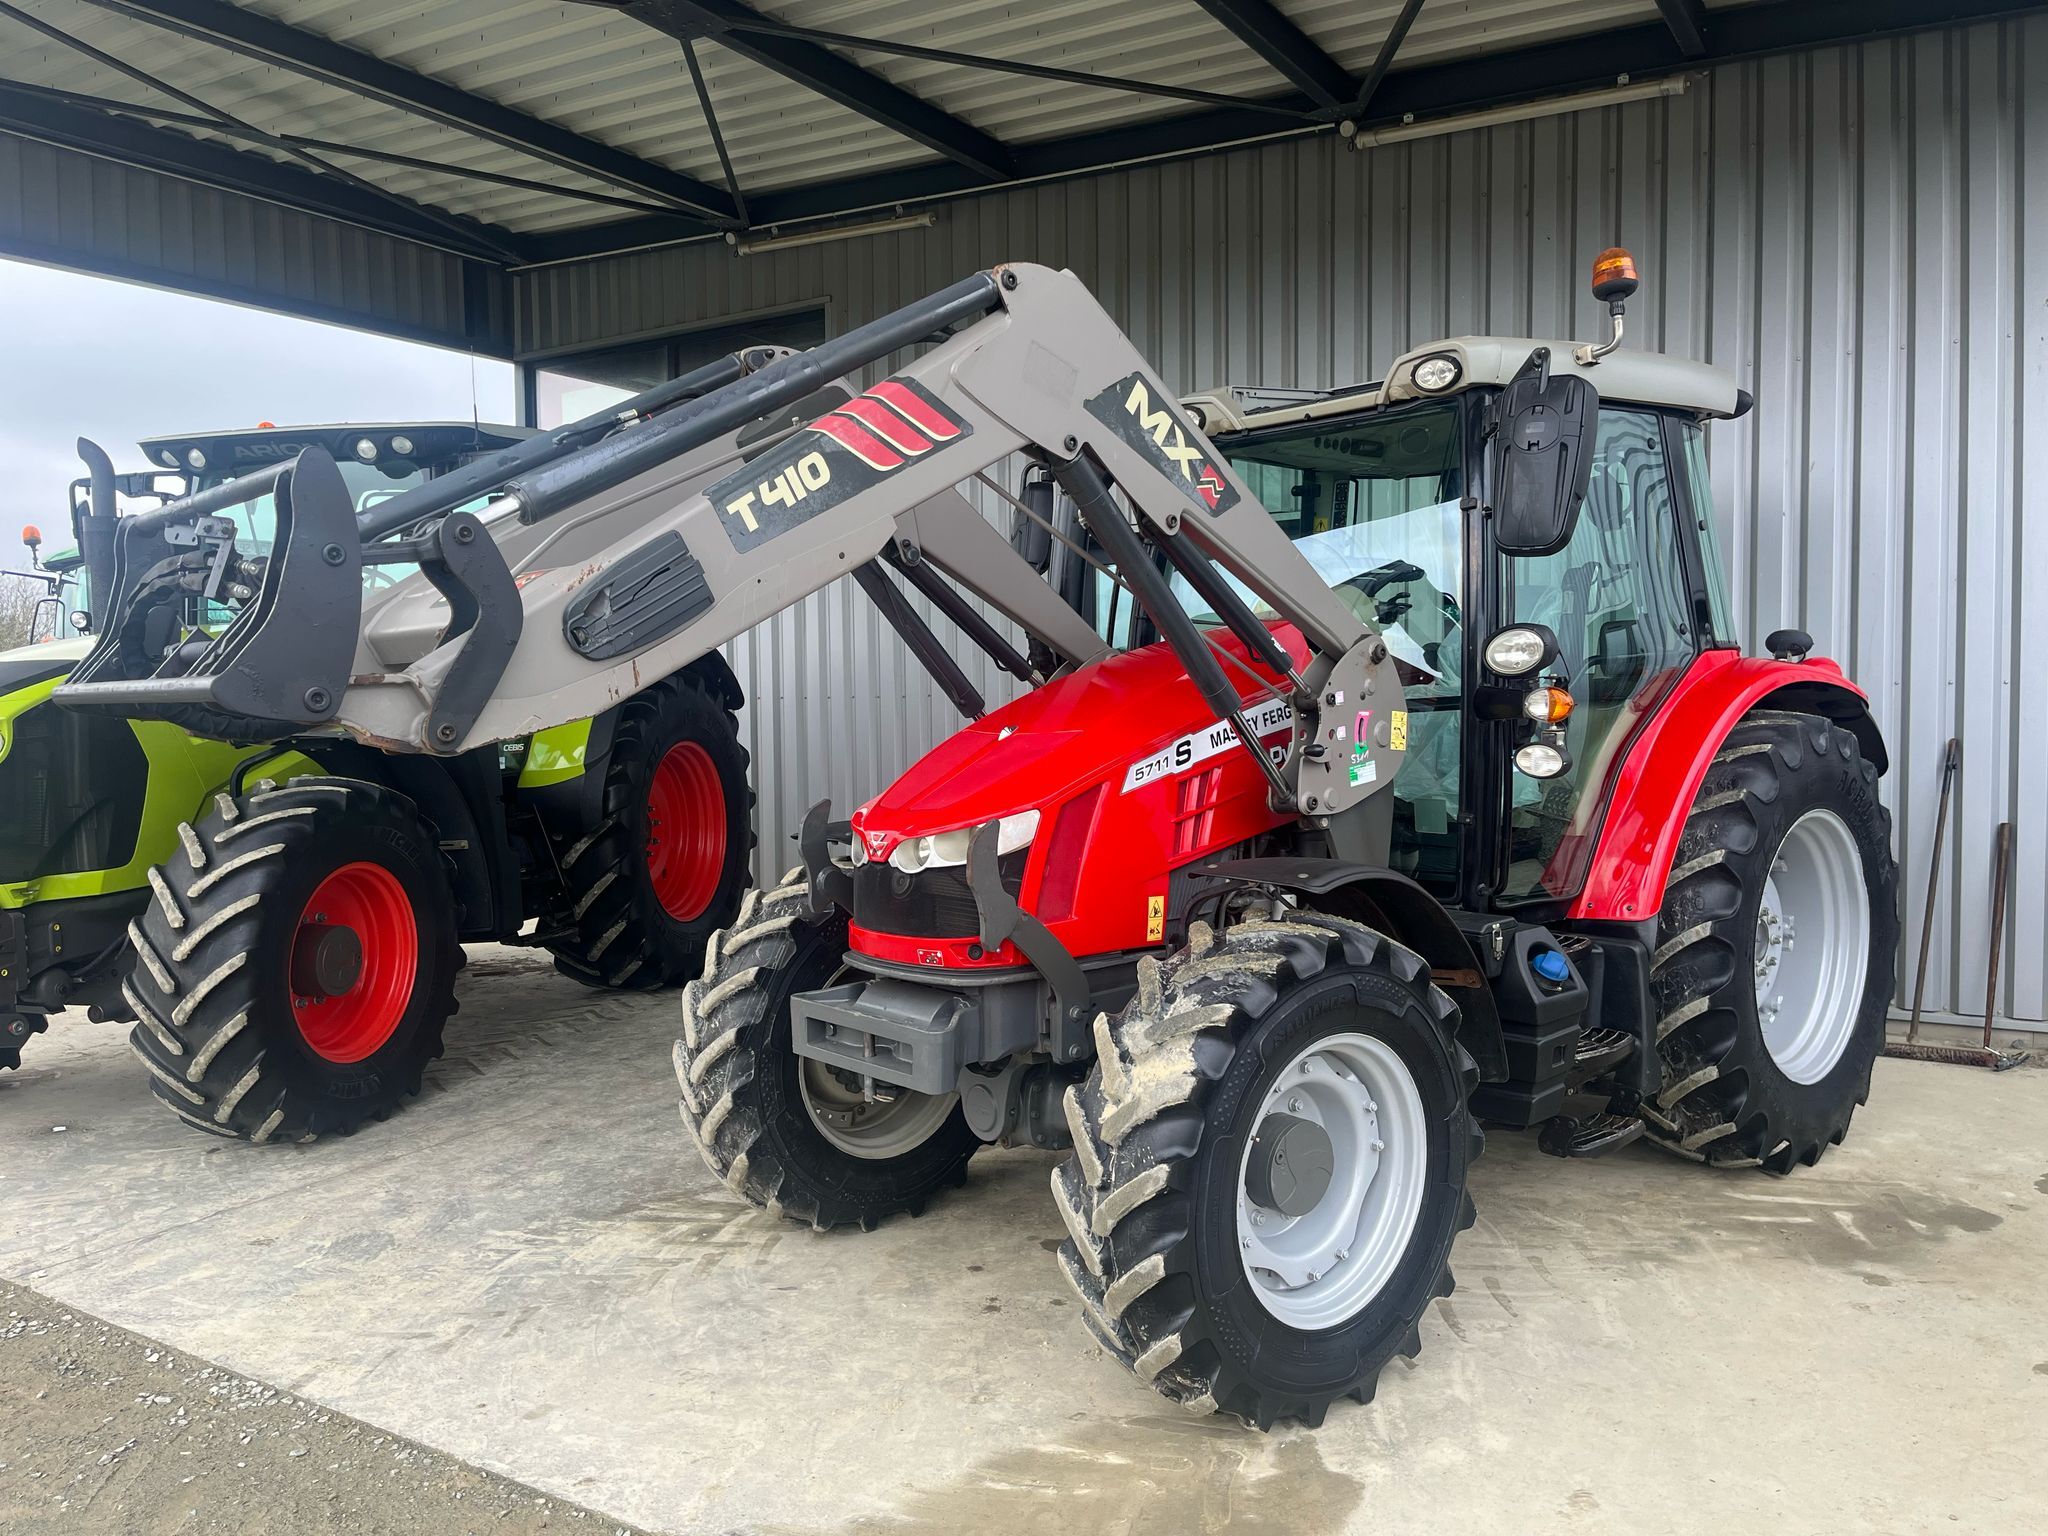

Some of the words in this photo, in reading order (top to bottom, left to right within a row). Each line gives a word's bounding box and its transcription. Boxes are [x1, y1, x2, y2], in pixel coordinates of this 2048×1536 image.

[234, 441, 322, 458] ARIO
[1125, 380, 1204, 482] MX
[726, 491, 759, 533] T
[759, 451, 831, 508] 410
[503, 743, 525, 751] CEBIS
[1135, 756, 1169, 781] 5711
[1176, 740, 1192, 766] S
